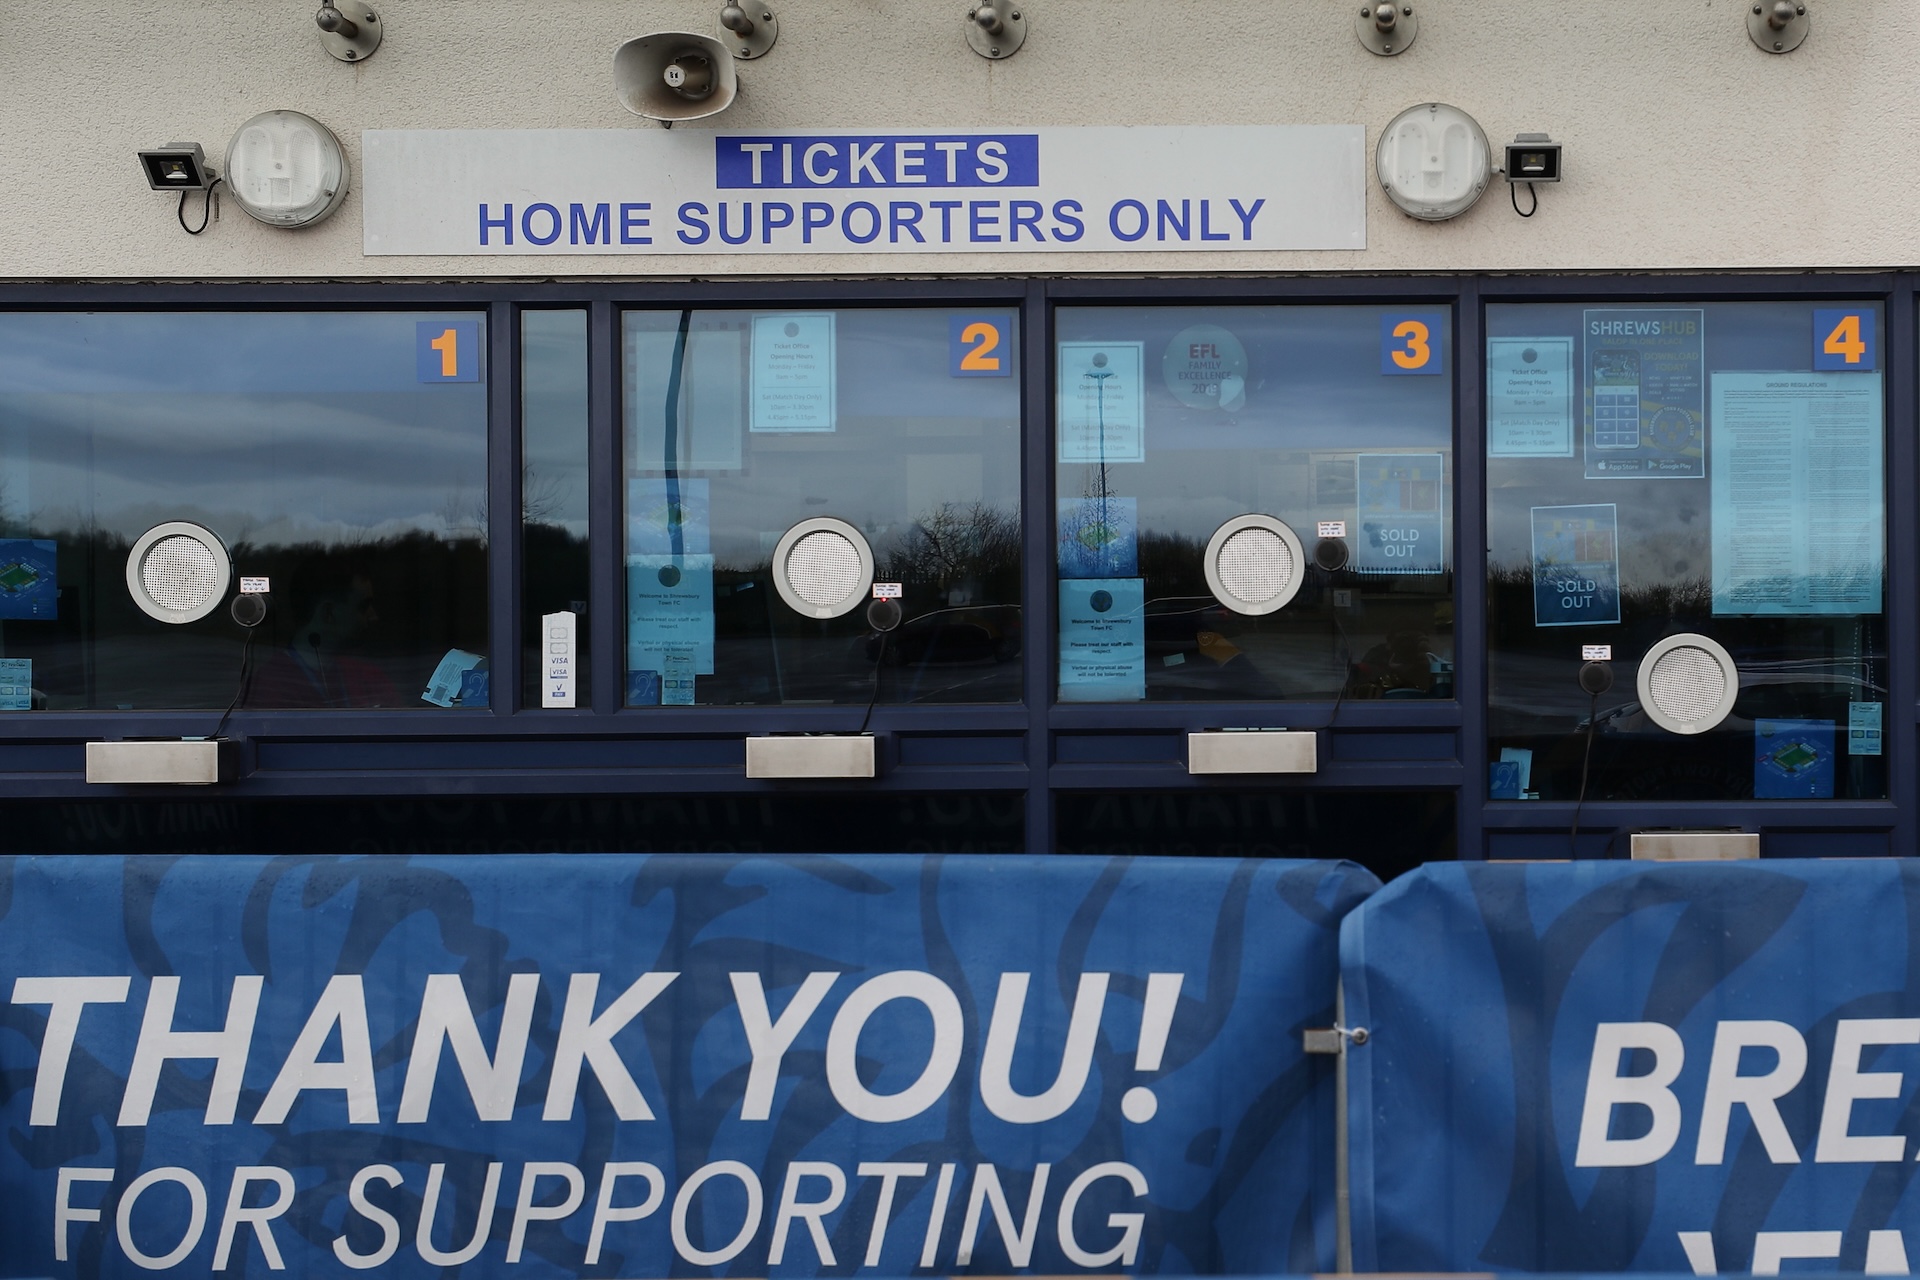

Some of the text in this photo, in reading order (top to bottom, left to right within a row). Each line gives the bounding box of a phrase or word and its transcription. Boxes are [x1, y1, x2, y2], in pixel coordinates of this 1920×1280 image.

[740, 140, 1010, 185] TICKETS
[479, 199, 1267, 245] HOME SUPPORTERS ONLY
[1590, 320, 1697, 336] SHREWSHUB
[960, 322, 1000, 370] 2
[1391, 320, 1431, 369] 3
[1823, 315, 1866, 364] 4
[432, 329, 457, 376] 1
[1189, 343, 1220, 359] EFL
[1188, 361, 1222, 370] FAMILY
[1178, 371, 1232, 380] EXCELLENCE
[1608, 463, 1622, 471] App
[1659, 463, 1692, 471] Google Play
[1380, 529, 1420, 541] SOLD
[1384, 545, 1416, 557] OUT
[1556, 580, 1596, 593] SOLD
[1561, 596, 1593, 609] OUT
[551, 657, 569, 665] VISA
[13, 969, 1185, 1127] THANK YOU!
[1575, 1018, 1920, 1168] BRE
[54, 1159, 1150, 1271] FOR SUPPORTING
